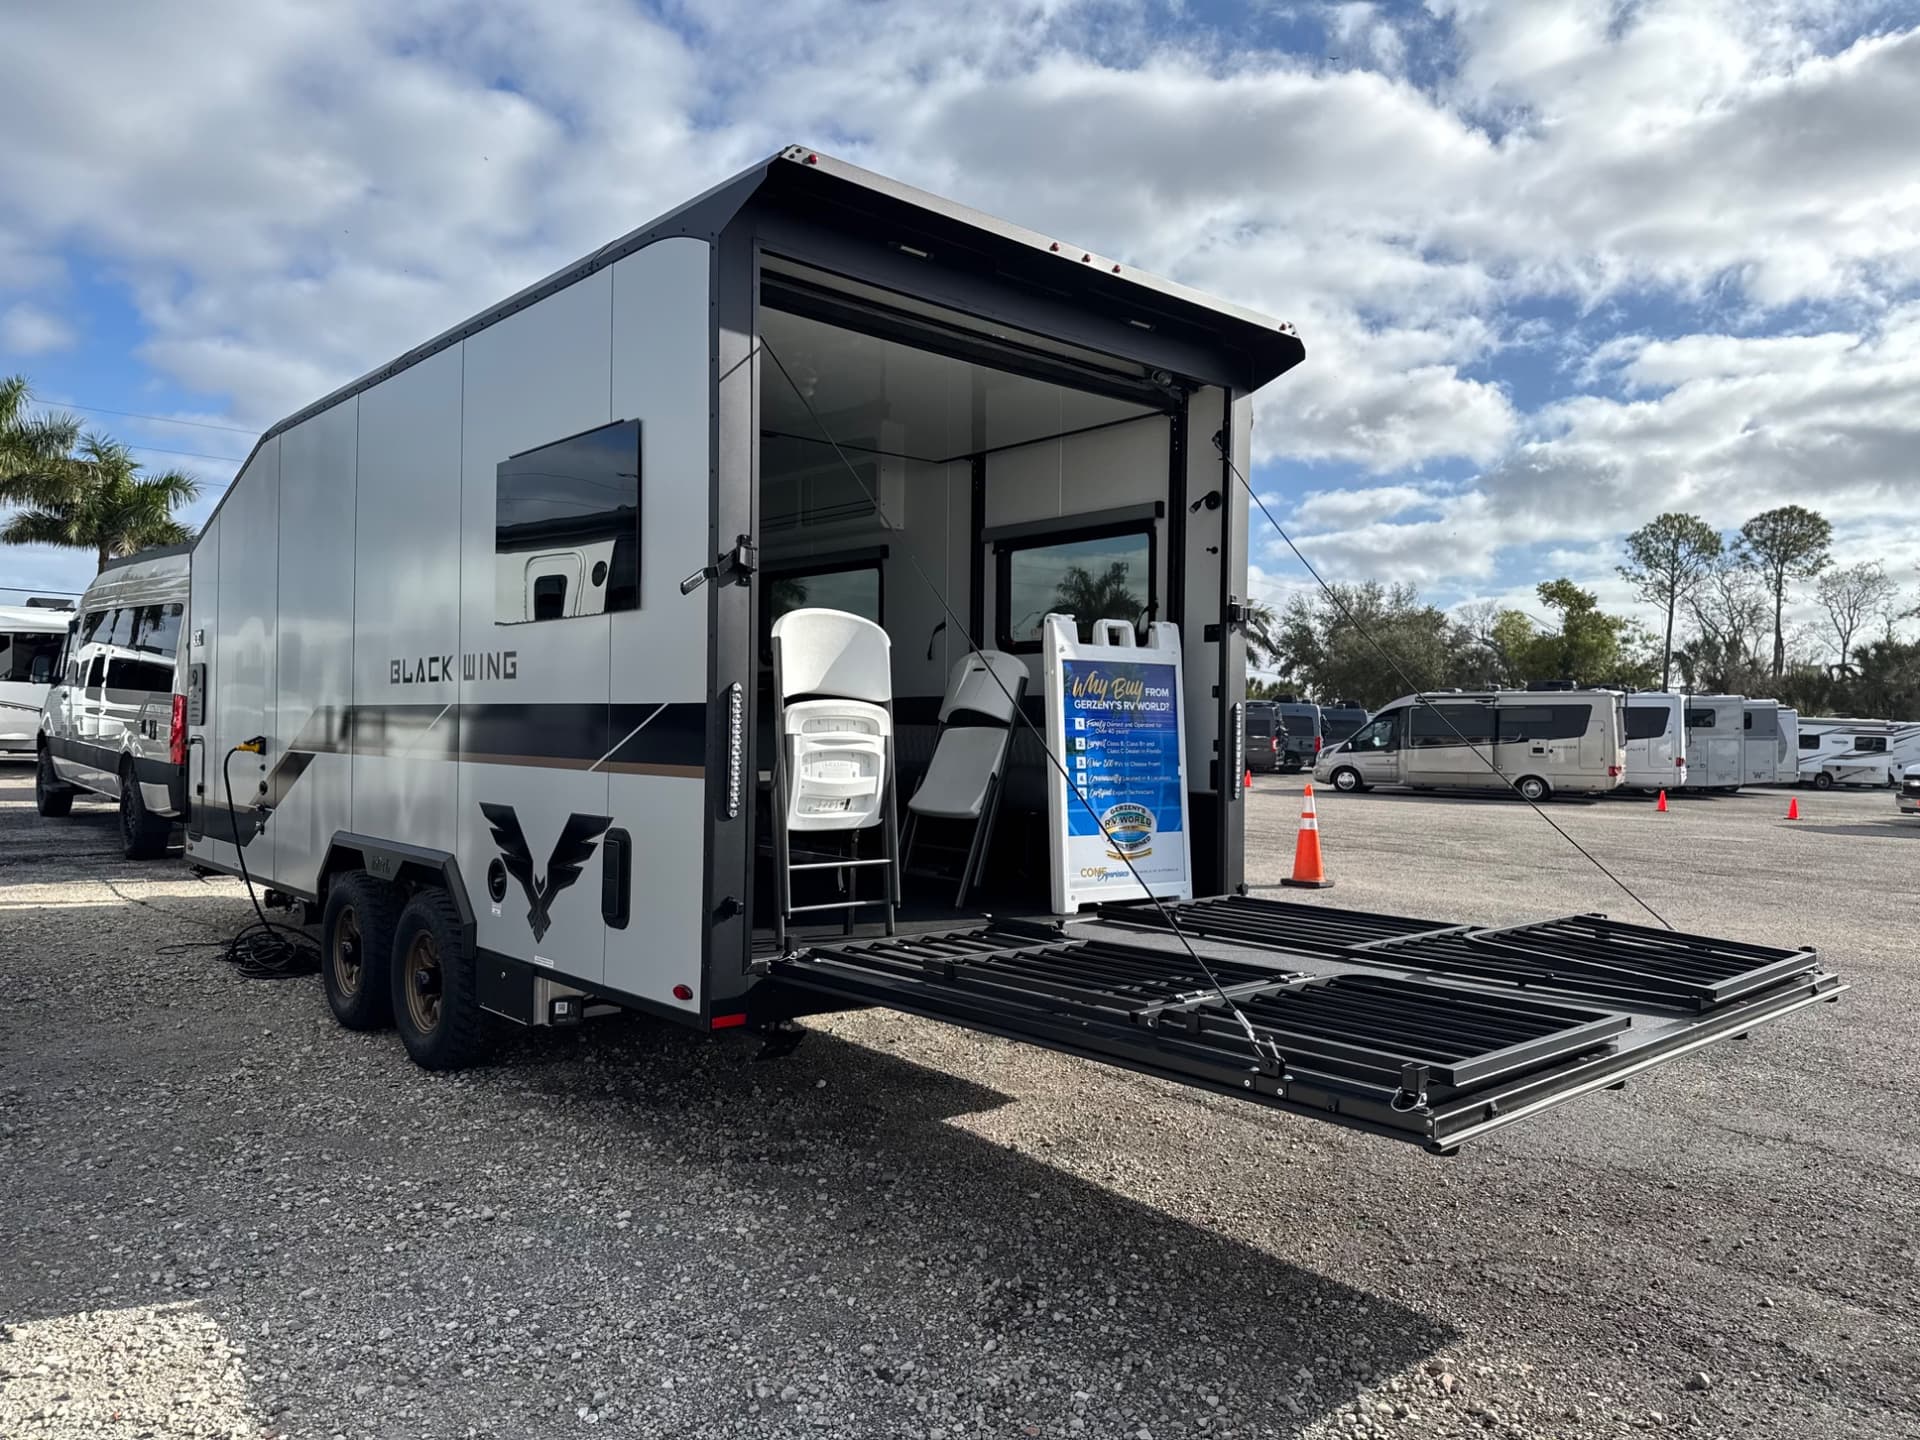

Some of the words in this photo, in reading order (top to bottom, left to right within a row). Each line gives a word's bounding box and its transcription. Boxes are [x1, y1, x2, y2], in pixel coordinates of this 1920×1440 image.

[390, 655, 453, 684] BLACK
[463, 651, 517, 681] WING
[1072, 671, 1108, 704] Why
[1111, 677, 1144, 704] Buy
[1145, 687, 1169, 697] FROM
[1074, 700, 1122, 710] GERZENY'S
[1123, 701, 1135, 711] RV
[1135, 702, 1170, 711] WORLD?
[1120, 815, 1152, 826] WORLD
